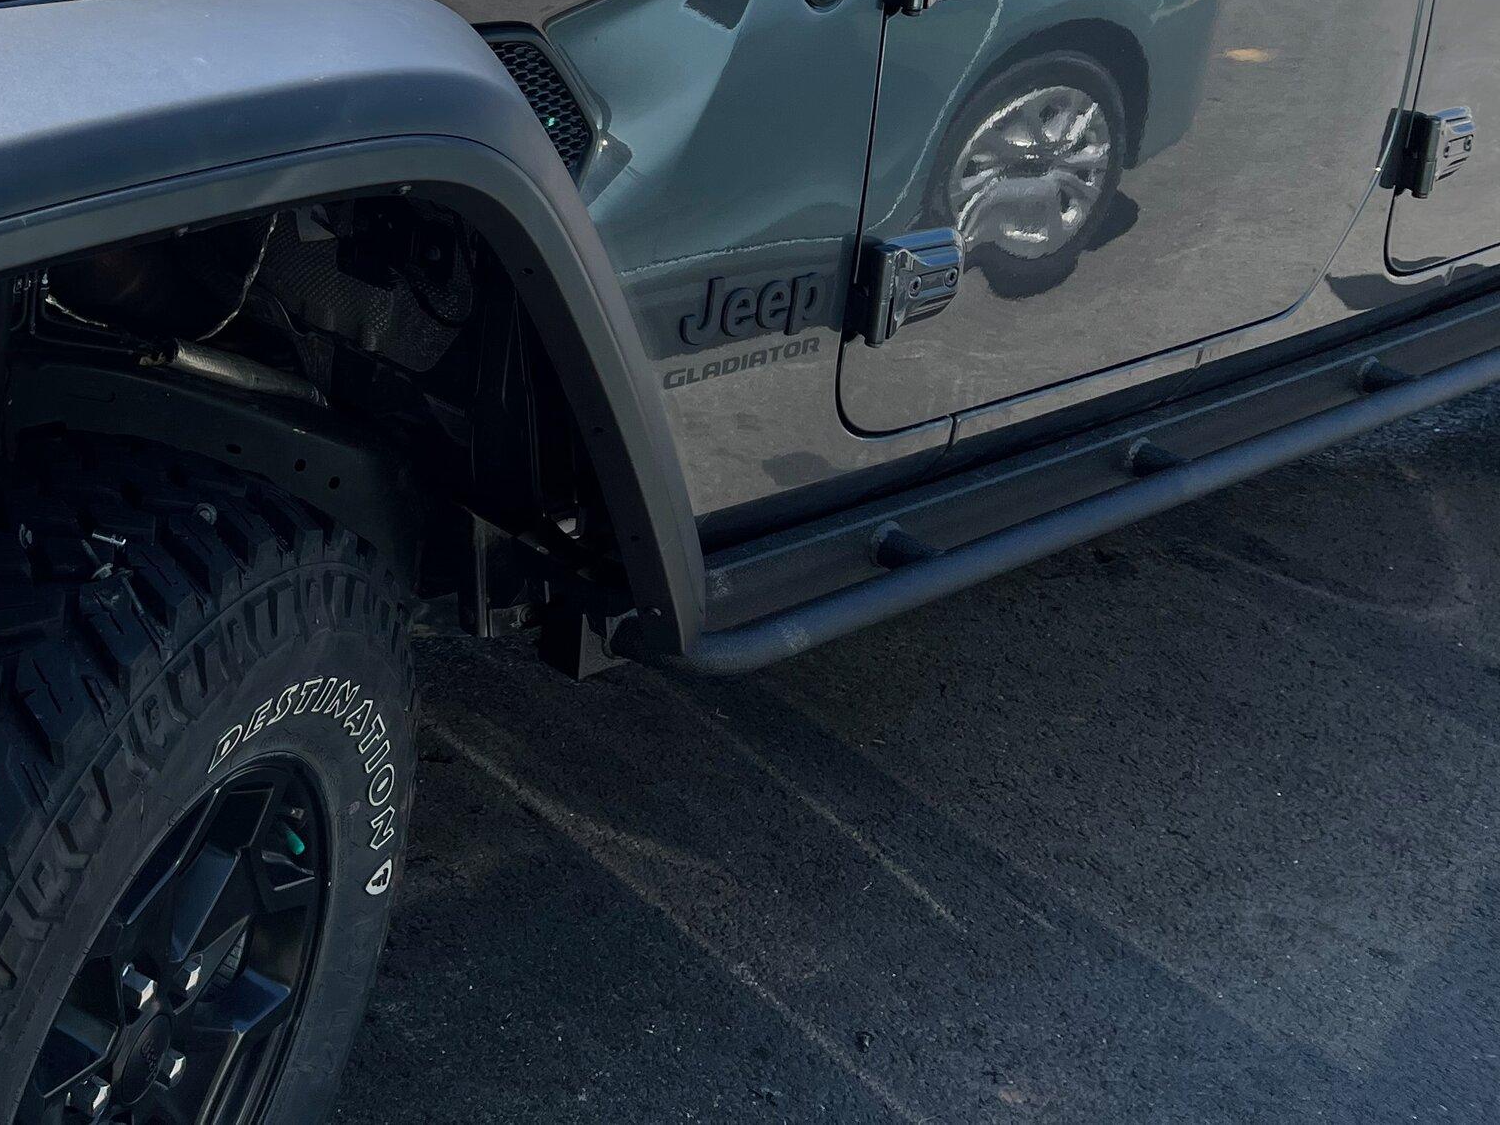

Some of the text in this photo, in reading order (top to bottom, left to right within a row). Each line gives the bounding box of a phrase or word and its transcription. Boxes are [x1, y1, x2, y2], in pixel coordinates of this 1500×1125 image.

[679, 271, 821, 346] Jeep
[662, 336, 820, 390] GLADIATOR
[207, 676, 396, 852] DESTINATION
